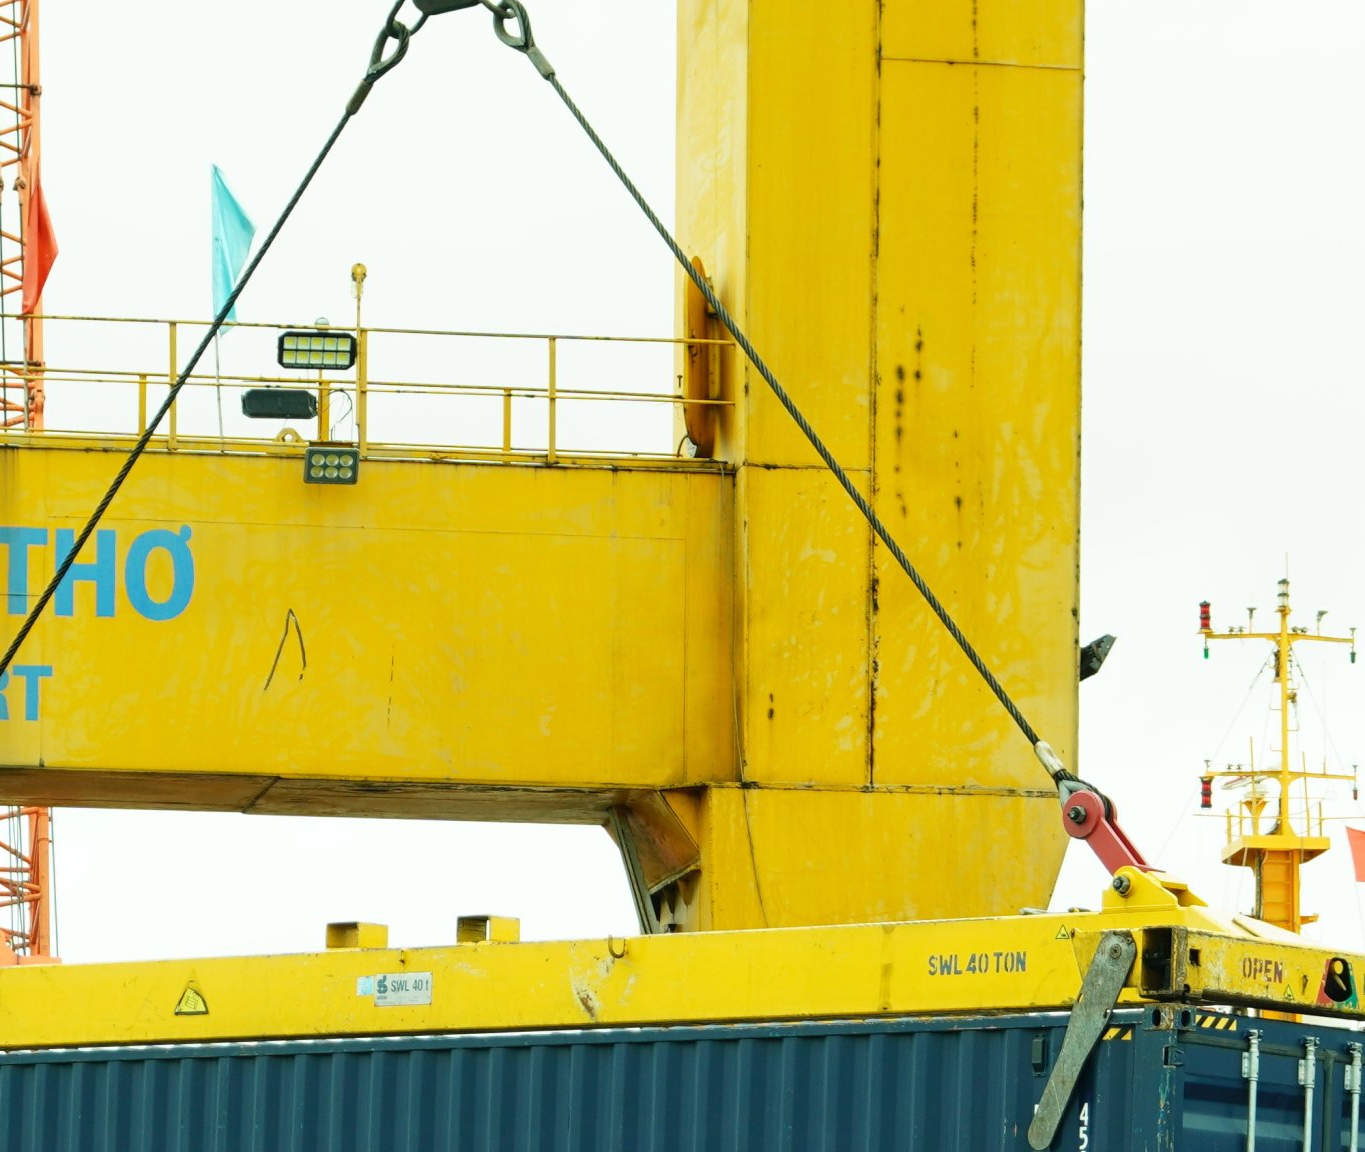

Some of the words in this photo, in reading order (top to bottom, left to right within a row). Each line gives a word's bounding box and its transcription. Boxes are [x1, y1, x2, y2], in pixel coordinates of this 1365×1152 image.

[928, 952, 963, 976] SWL
[965, 952, 990, 974] 40
[992, 950, 1028, 974] TON
[1242, 956, 1284, 984] OPEN
[391, 979, 410, 992] SWL
[412, 979, 423, 991] 40
